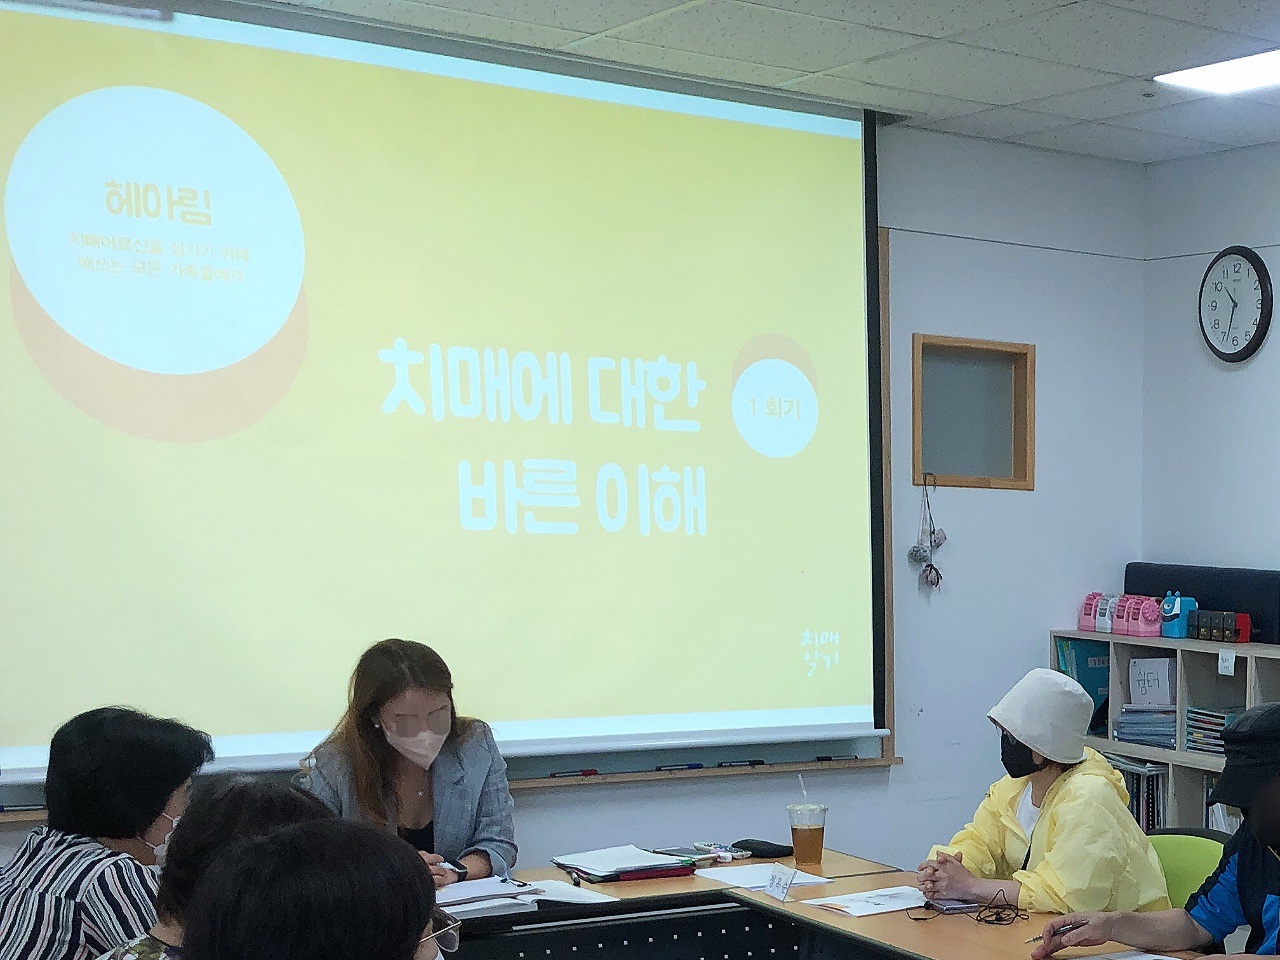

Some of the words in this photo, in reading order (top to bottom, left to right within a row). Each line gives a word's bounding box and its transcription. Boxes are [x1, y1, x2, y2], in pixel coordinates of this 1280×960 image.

[104, 179, 212, 226] 헤아림
[1222, 269, 1229, 279] 11
[1233, 263, 1242, 274] 12
[1214, 281, 1223, 292] 10
[1254, 280, 1260, 291] 2
[1210, 300, 1218, 311] 9
[1256, 299, 1262, 309] 3
[1213, 319, 1220, 330] 8
[1252, 317, 1259, 327] 4
[1221, 331, 1227, 345] 7
[1231, 336, 1239, 347] 6
[1244, 331, 1251, 342] 5
[377, 337, 573, 426] 치매에
[588, 354, 707, 432] 대한
[749, 396, 757, 416] 1
[765, 396, 801, 421] 회기
[457, 458, 581, 535] 바른
[596, 462, 708, 537] 이해
[801, 628, 840, 647] 치매
[803, 649, 840, 678] 알기
